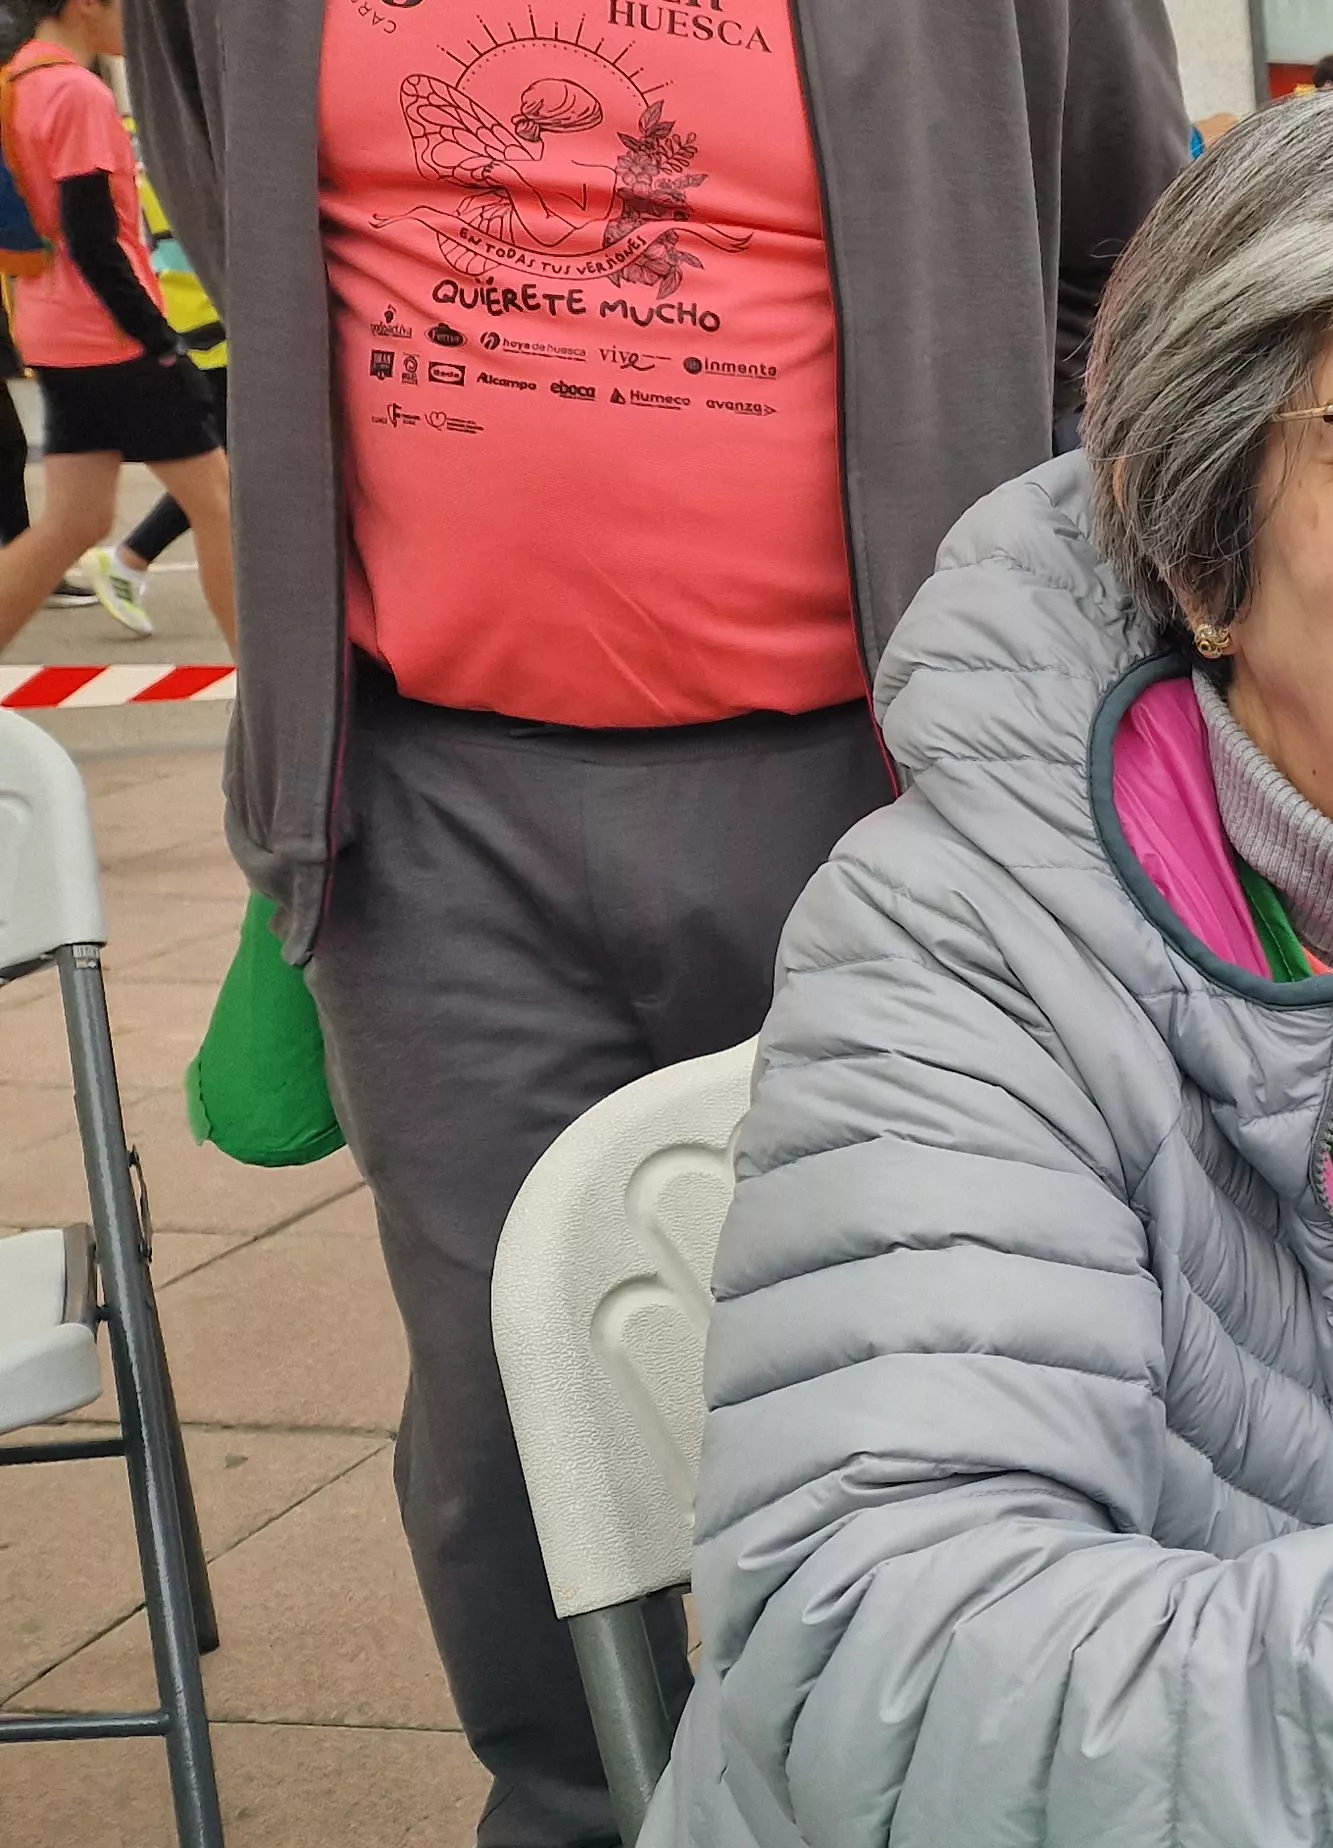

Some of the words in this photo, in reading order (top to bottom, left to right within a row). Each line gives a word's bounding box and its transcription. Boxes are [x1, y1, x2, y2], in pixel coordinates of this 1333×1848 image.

[607, 0, 772, 53] HUESCA
[459, 227, 482, 247] EN
[485, 243, 536, 268] TODAS
[540, 261, 571, 276] TUS
[600, 298, 721, 333] MUCHO
[502, 338, 530, 350] hoya
[546, 343, 586, 357] huesca
[476, 371, 538, 391] Alcampo
[630, 389, 691, 407] Humeco
[706, 399, 763, 414] avanza
